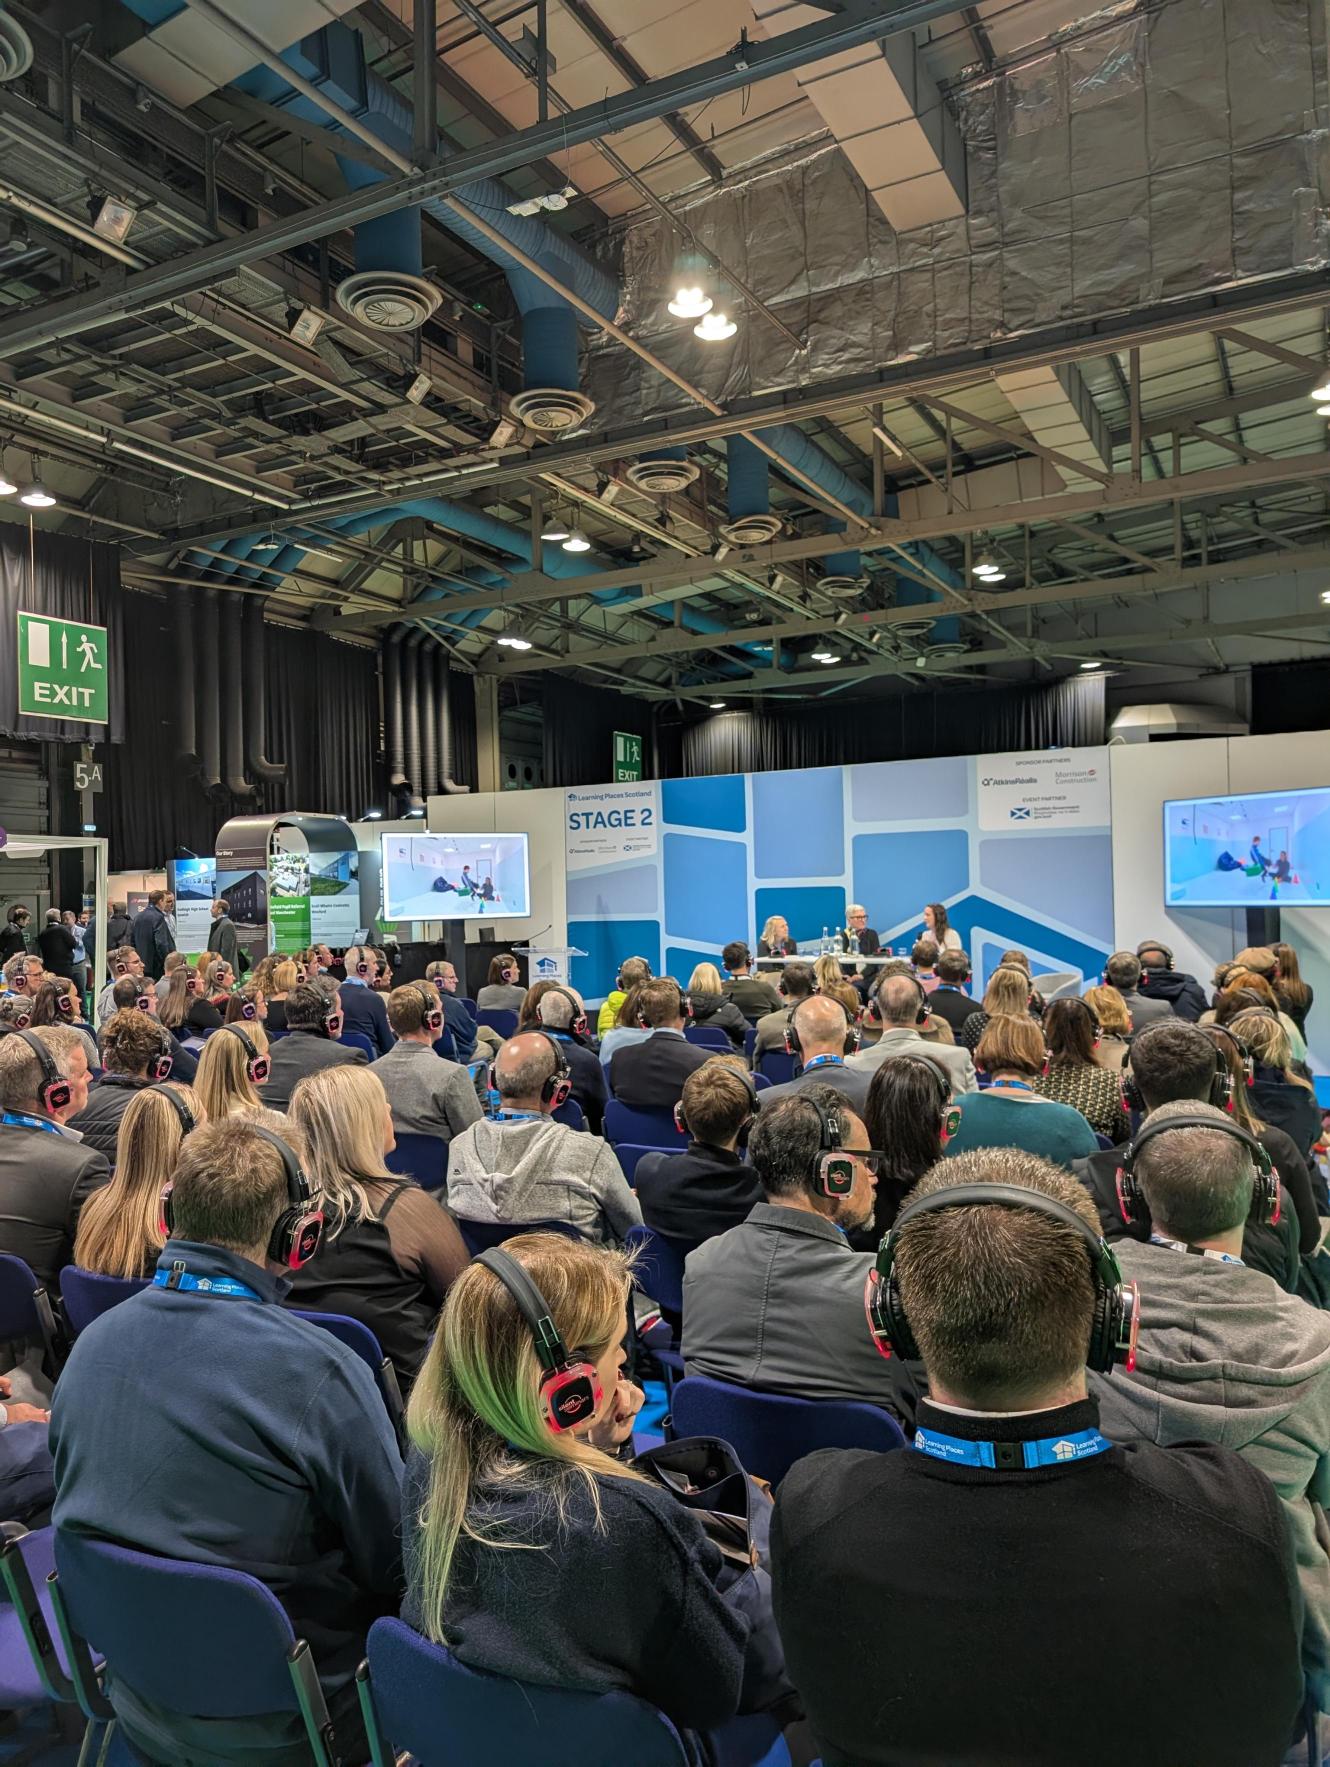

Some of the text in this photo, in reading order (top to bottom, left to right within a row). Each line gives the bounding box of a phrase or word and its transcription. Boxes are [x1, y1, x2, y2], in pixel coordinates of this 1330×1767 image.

[34, 681, 95, 707] EXIT
[619, 769, 638, 782] EXIT
[1055, 770, 1087, 778] Morrison
[1055, 777, 1097, 785] Construction
[578, 793, 604, 802] Learning
[569, 807, 653, 831] STAGE 2
[925, 1439, 965, 1455] Learning Places
[1075, 1439, 1097, 1449] Learning
[925, 1445, 947, 1457] Scotland
[1077, 1445, 1099, 1457] Scotland
